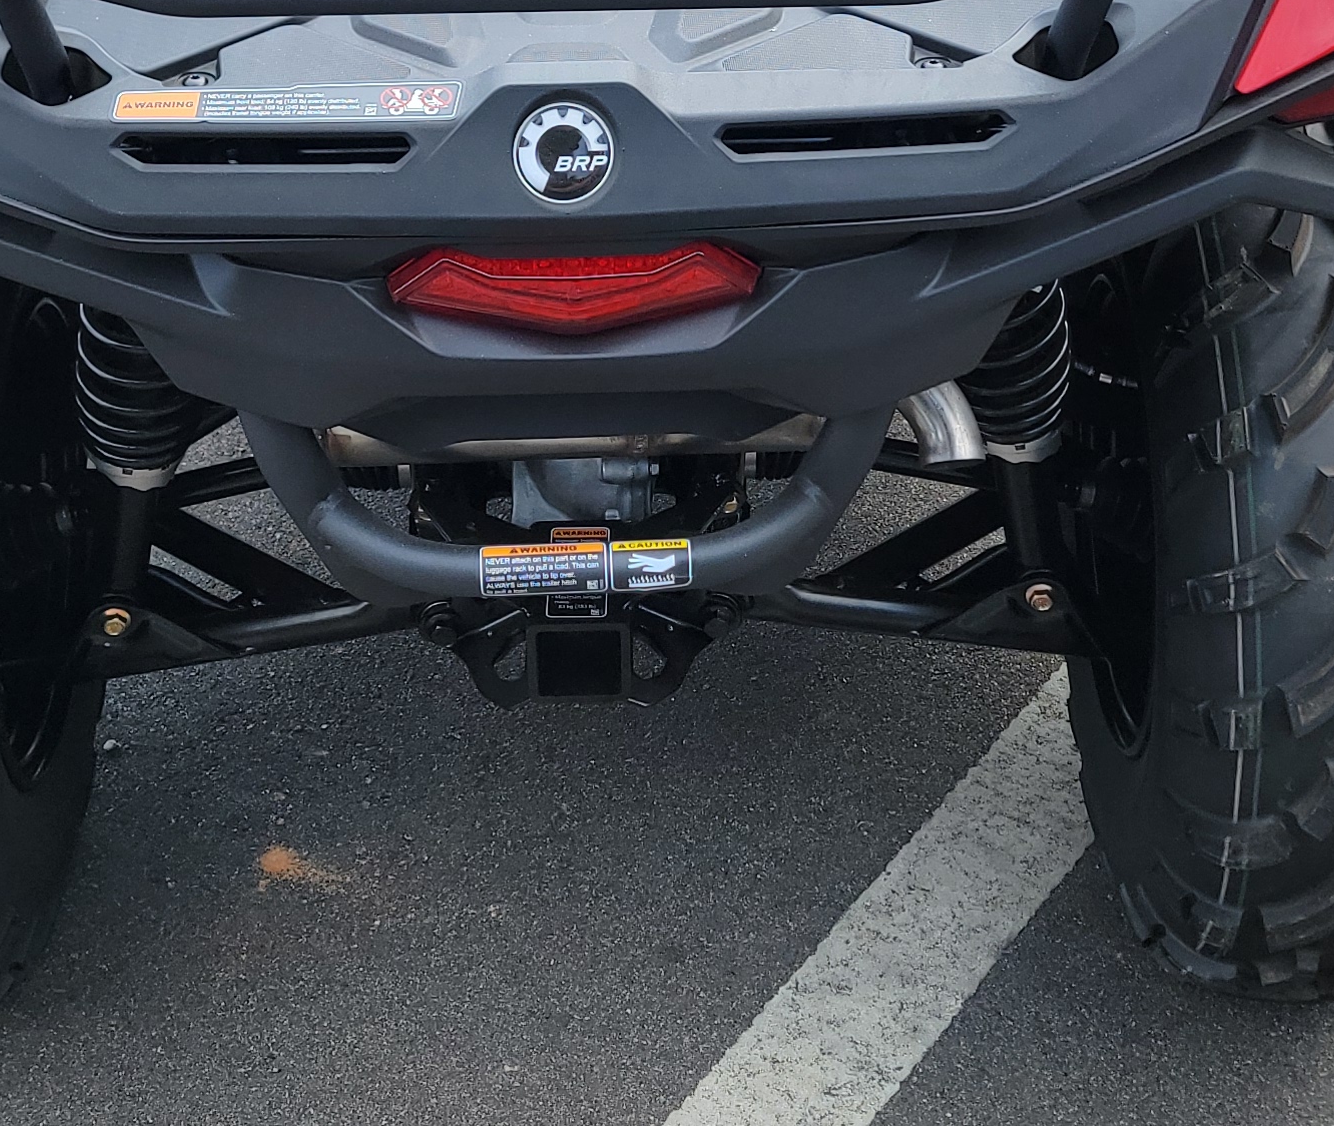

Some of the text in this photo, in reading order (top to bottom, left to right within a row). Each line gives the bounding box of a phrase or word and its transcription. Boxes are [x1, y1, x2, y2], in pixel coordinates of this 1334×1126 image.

[554, 155, 608, 172] BRP
[520, 545, 577, 553] WARNING
[628, 541, 682, 549] CAUTION
[556, 555, 568, 563] part
[486, 566, 511, 575] luggage
[536, 564, 547, 572] pull
[550, 572, 558, 580] tip
